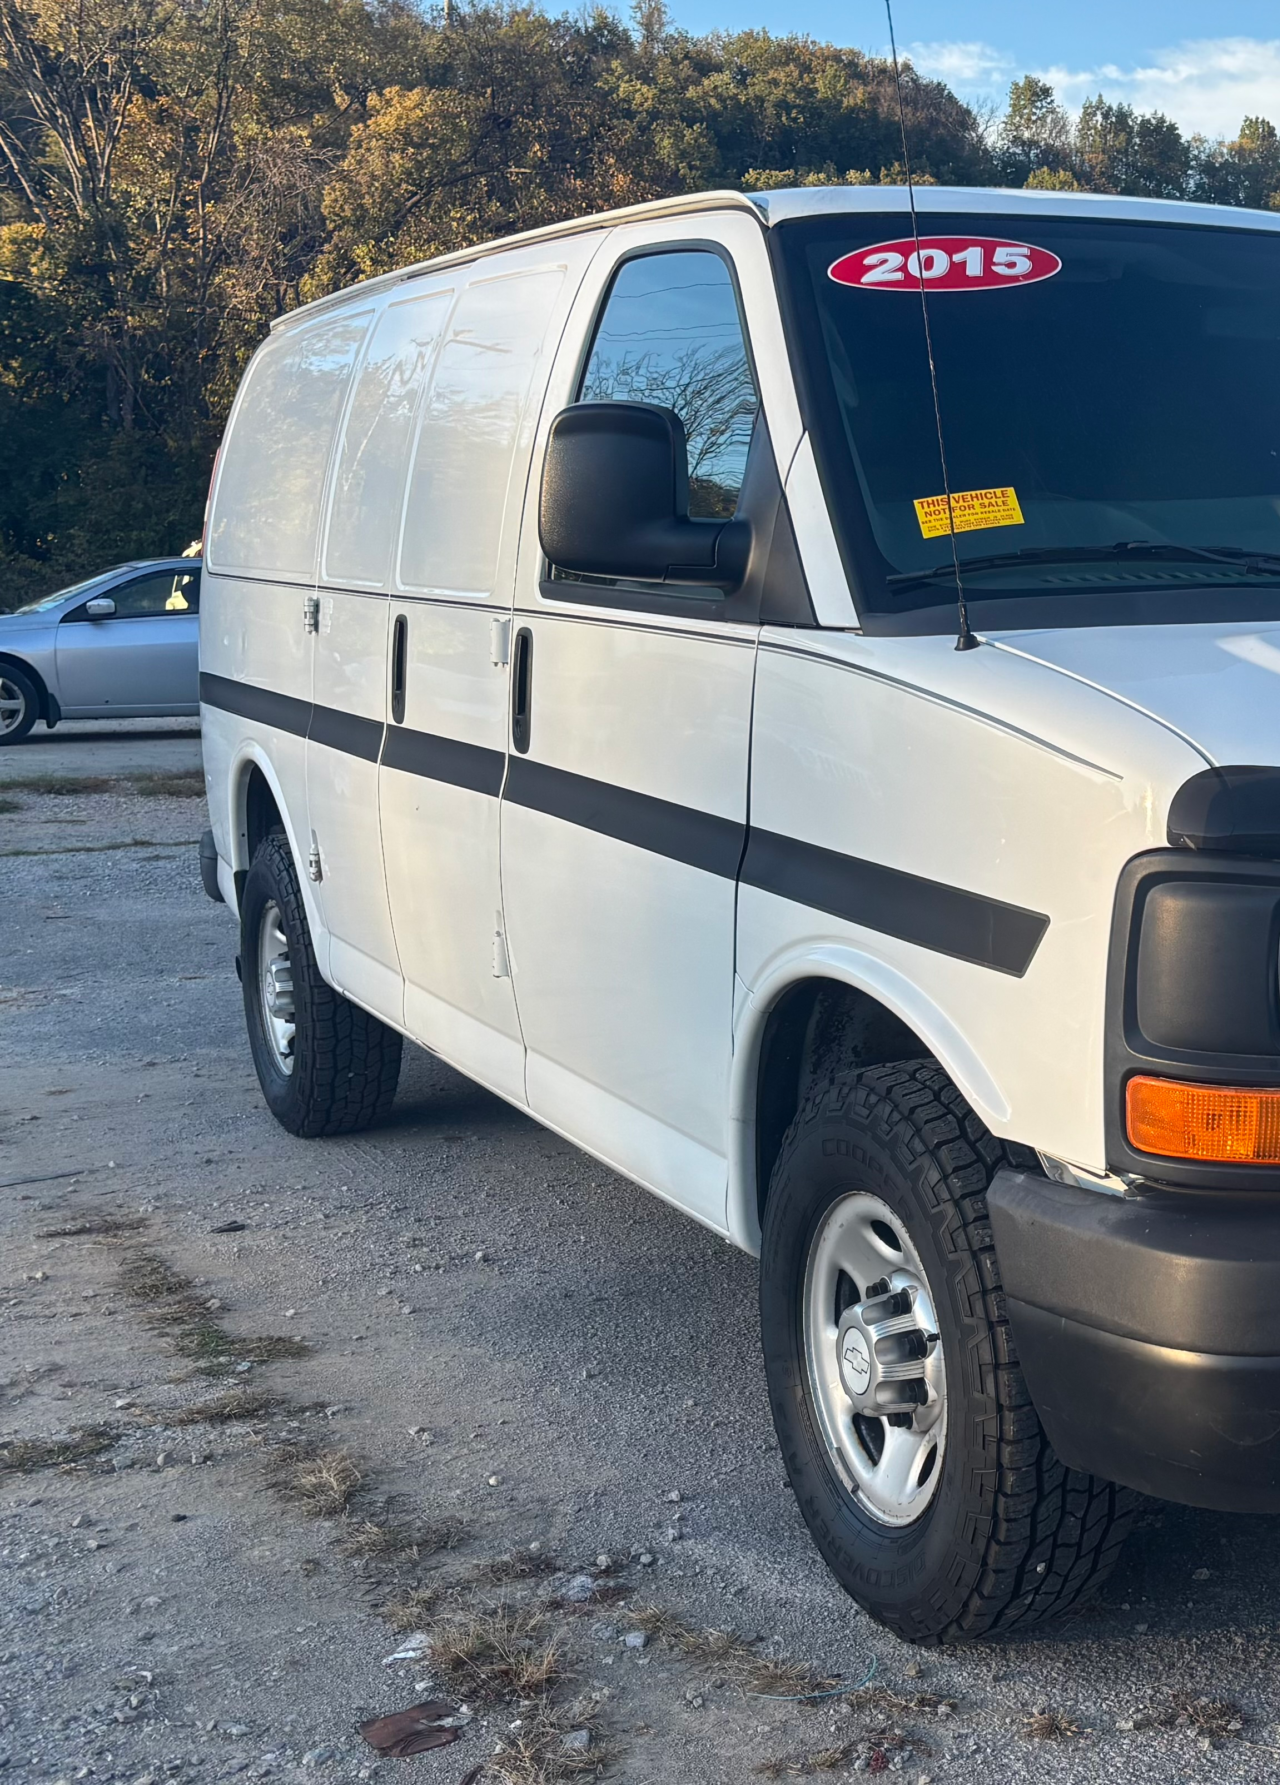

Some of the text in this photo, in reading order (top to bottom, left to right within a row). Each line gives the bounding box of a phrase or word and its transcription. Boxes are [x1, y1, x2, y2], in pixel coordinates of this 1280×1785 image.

[860, 247, 1032, 284] 2015
[918, 490, 1010, 510] THIS VEHICLE
[925, 500, 1009, 518] NOT FOR SALE
[821, 1138, 914, 1222] COOPER
[804, 1495, 927, 1590] DISCOVERER
